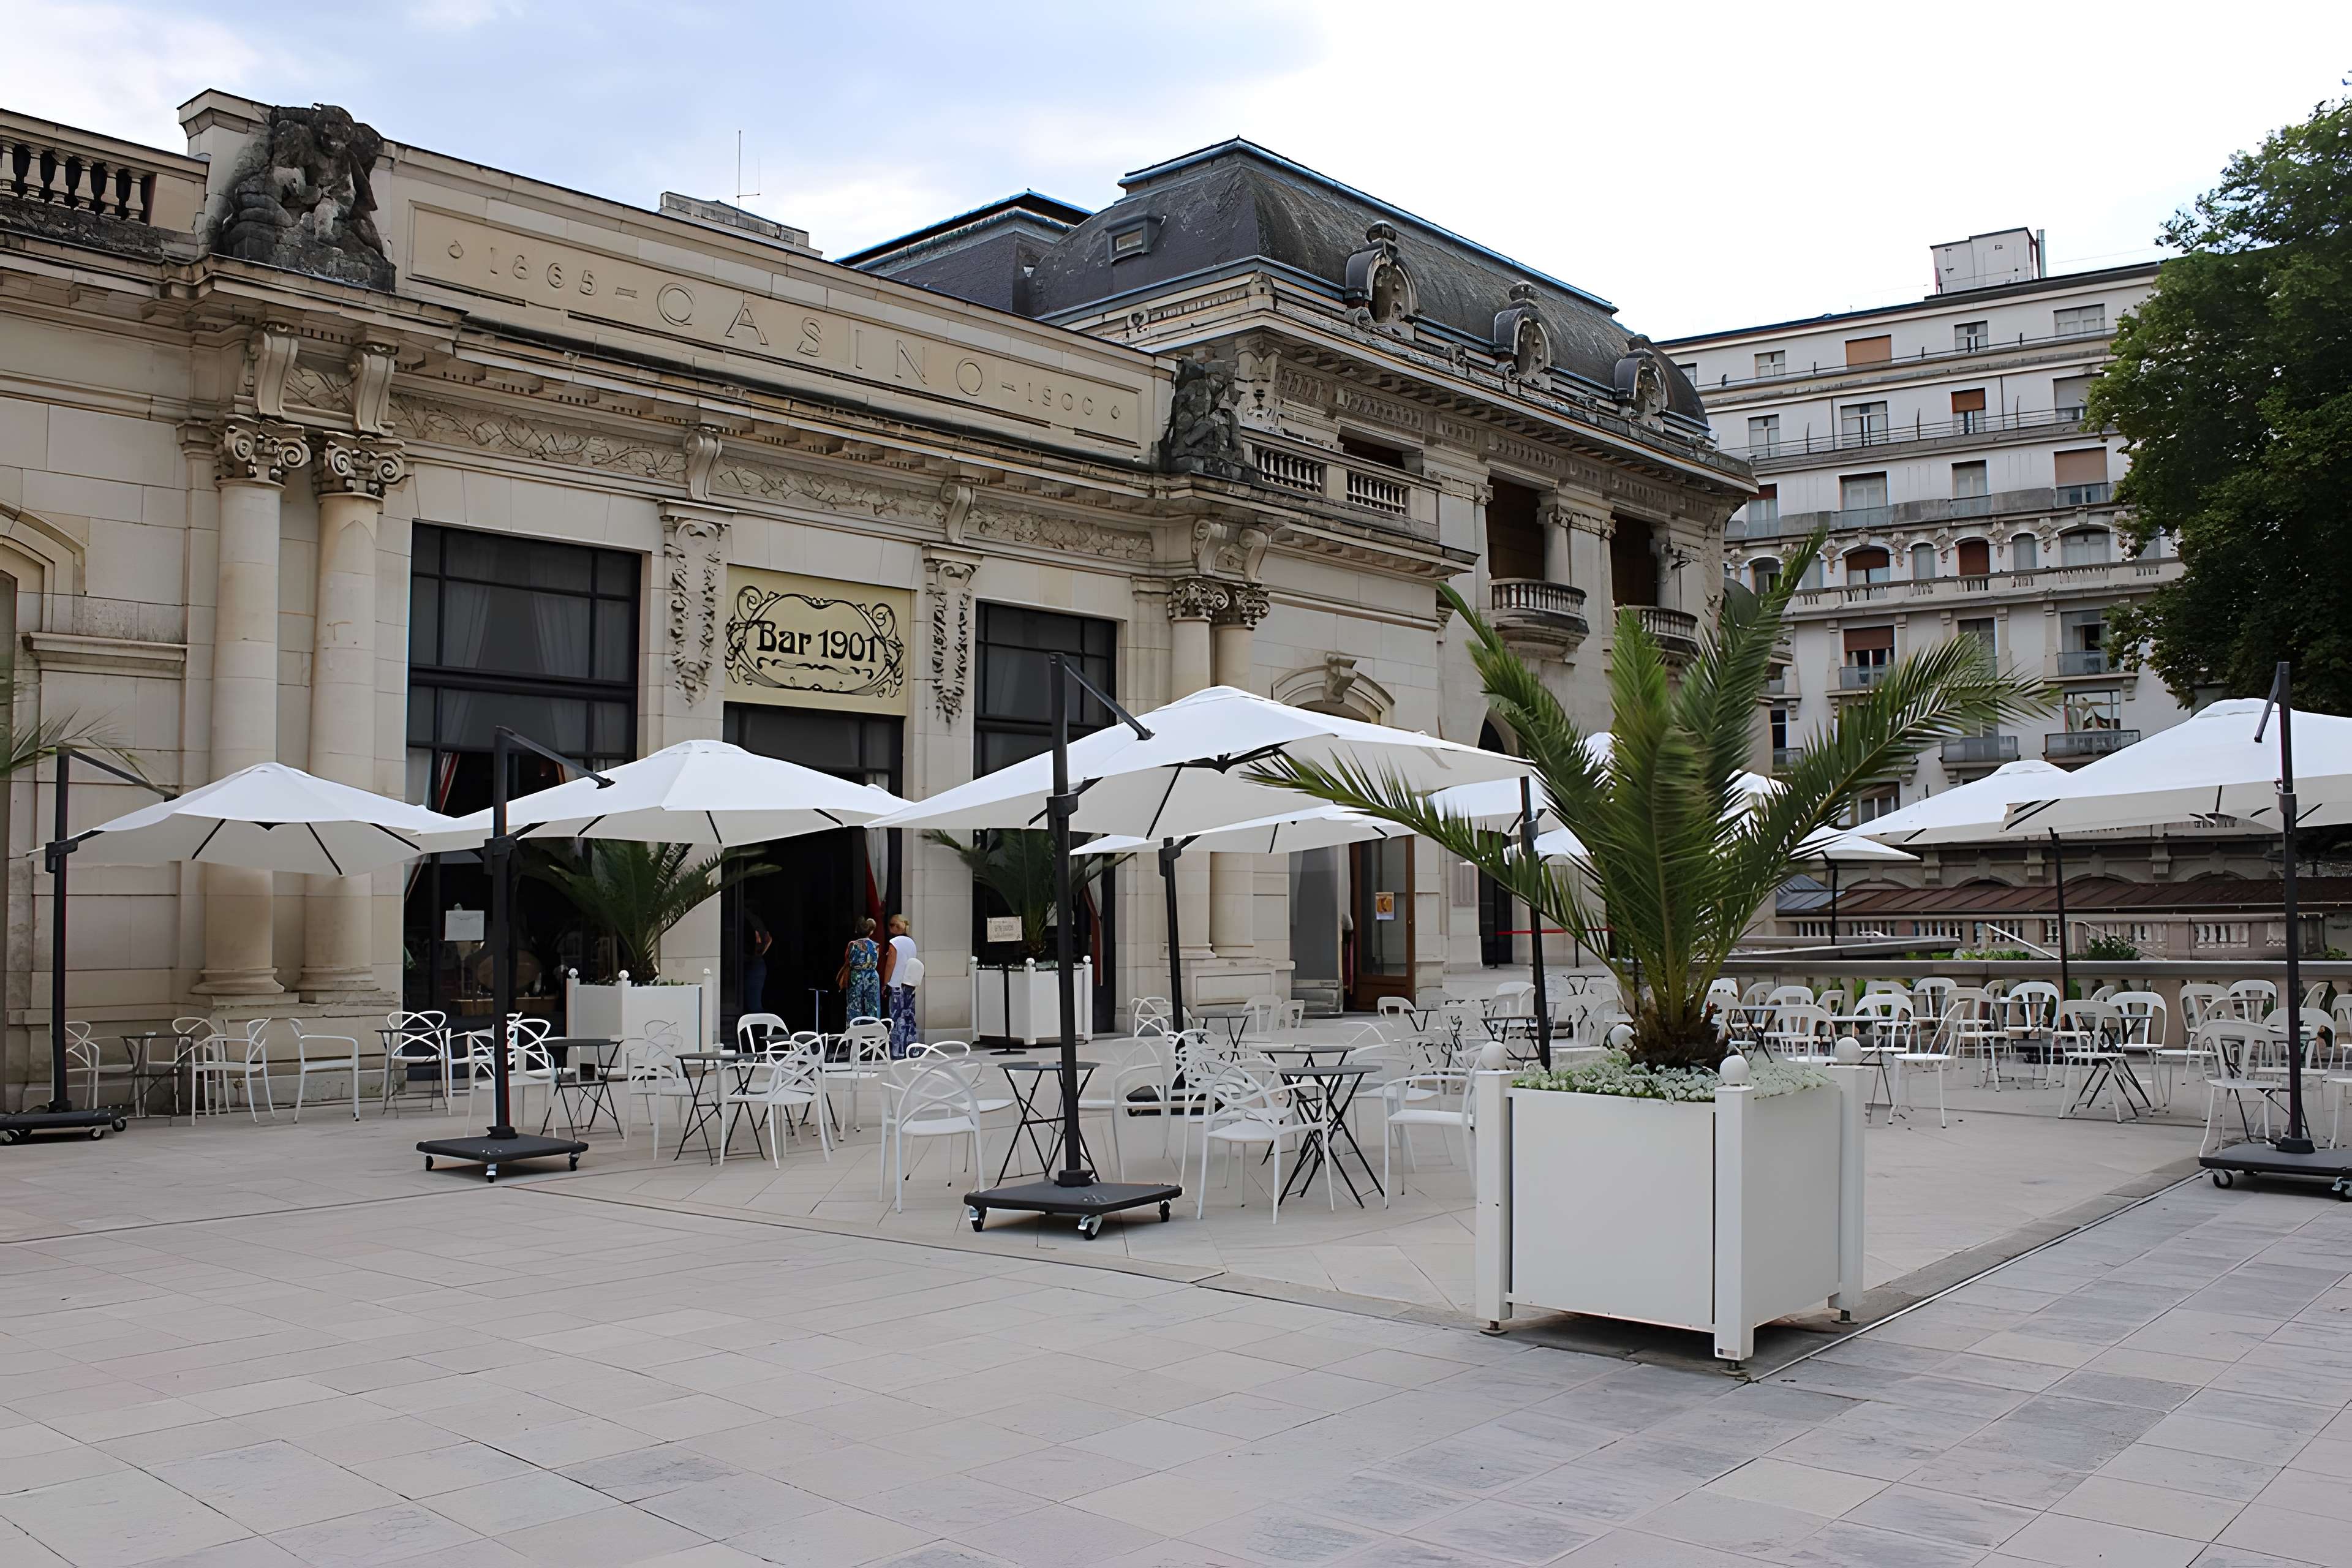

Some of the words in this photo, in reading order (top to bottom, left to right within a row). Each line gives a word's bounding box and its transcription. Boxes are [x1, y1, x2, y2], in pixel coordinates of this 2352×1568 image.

[657, 282, 984, 396] CASINO
[755, 620, 812, 655] Bar
[818, 629, 876, 663] 1901
